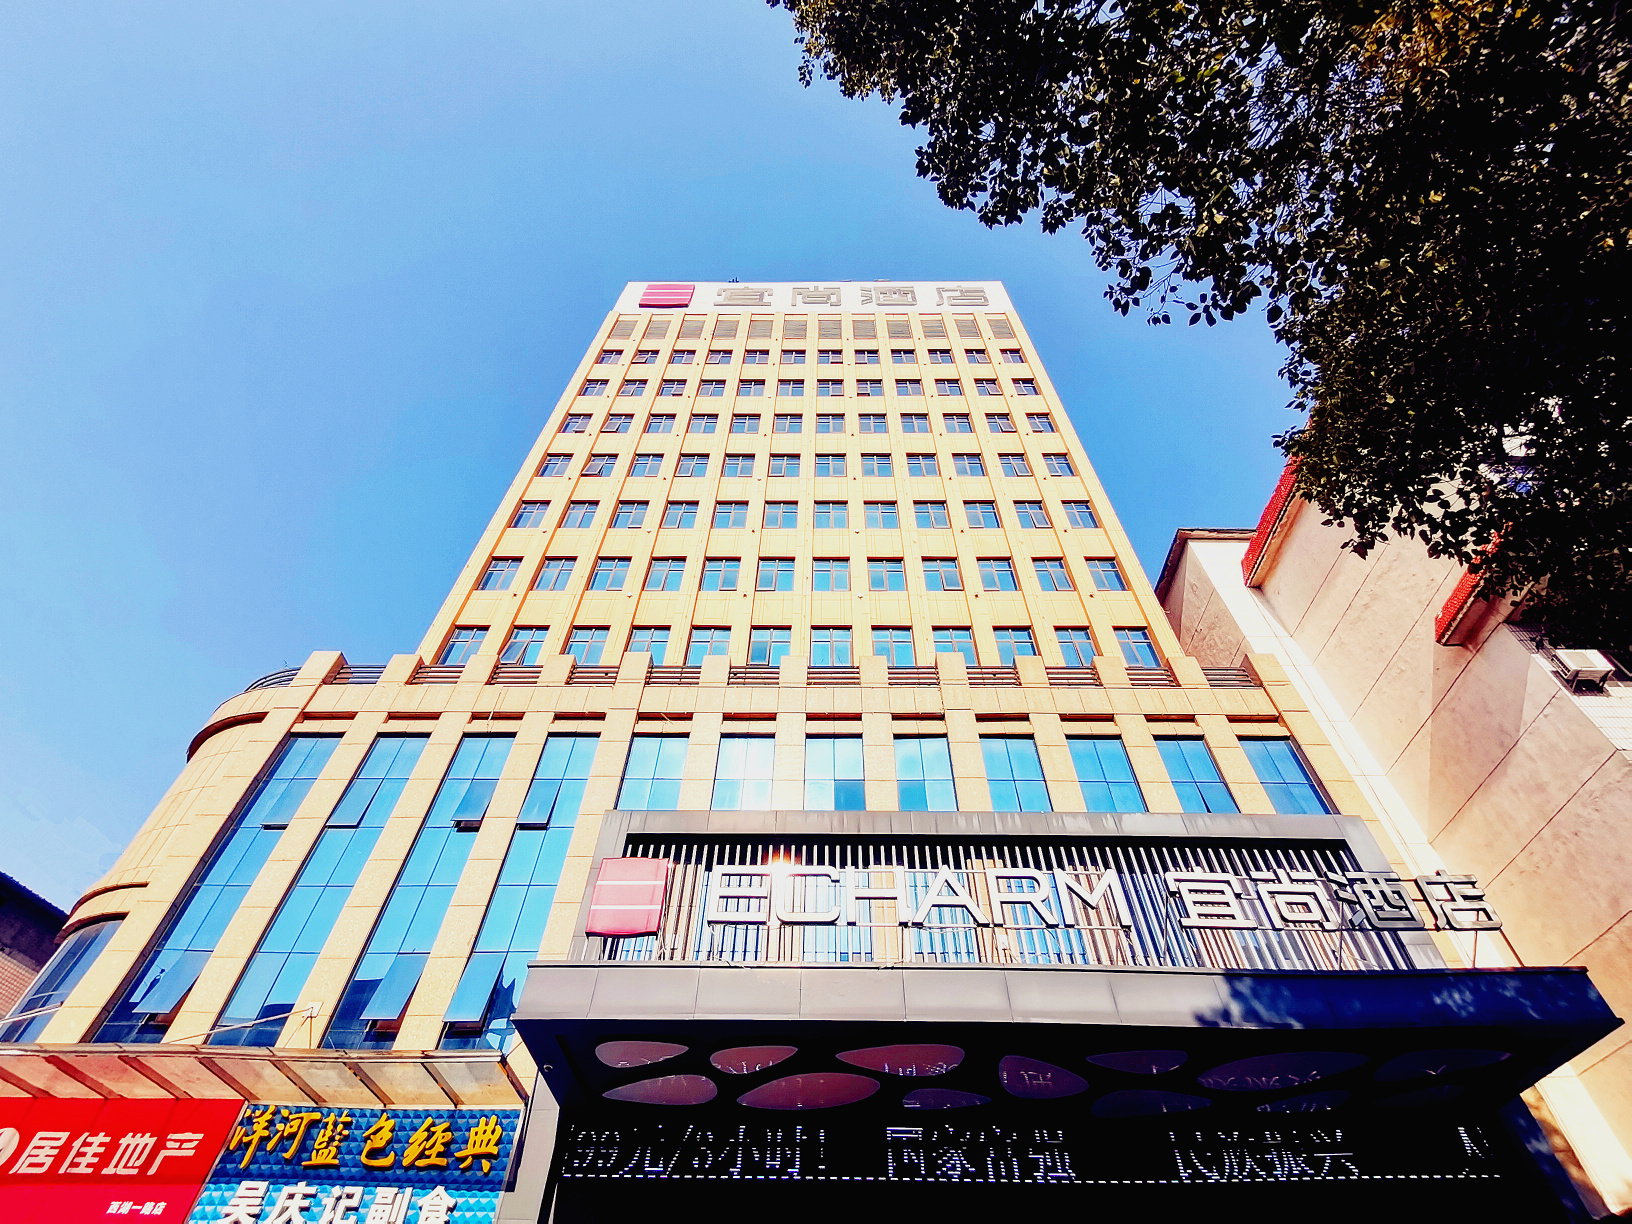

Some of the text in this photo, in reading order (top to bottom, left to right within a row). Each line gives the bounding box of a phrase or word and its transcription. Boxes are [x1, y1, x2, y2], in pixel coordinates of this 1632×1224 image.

[713, 285, 990, 307] 宜尚酒店
[707, 864, 1503, 932] ECHARM 宜尚酒店
[8, 1131, 205, 1176] 居佳地产
[106, 1200, 168, 1216] 西湖一路店
[216, 1179, 459, 1224] 吴庆记副食
